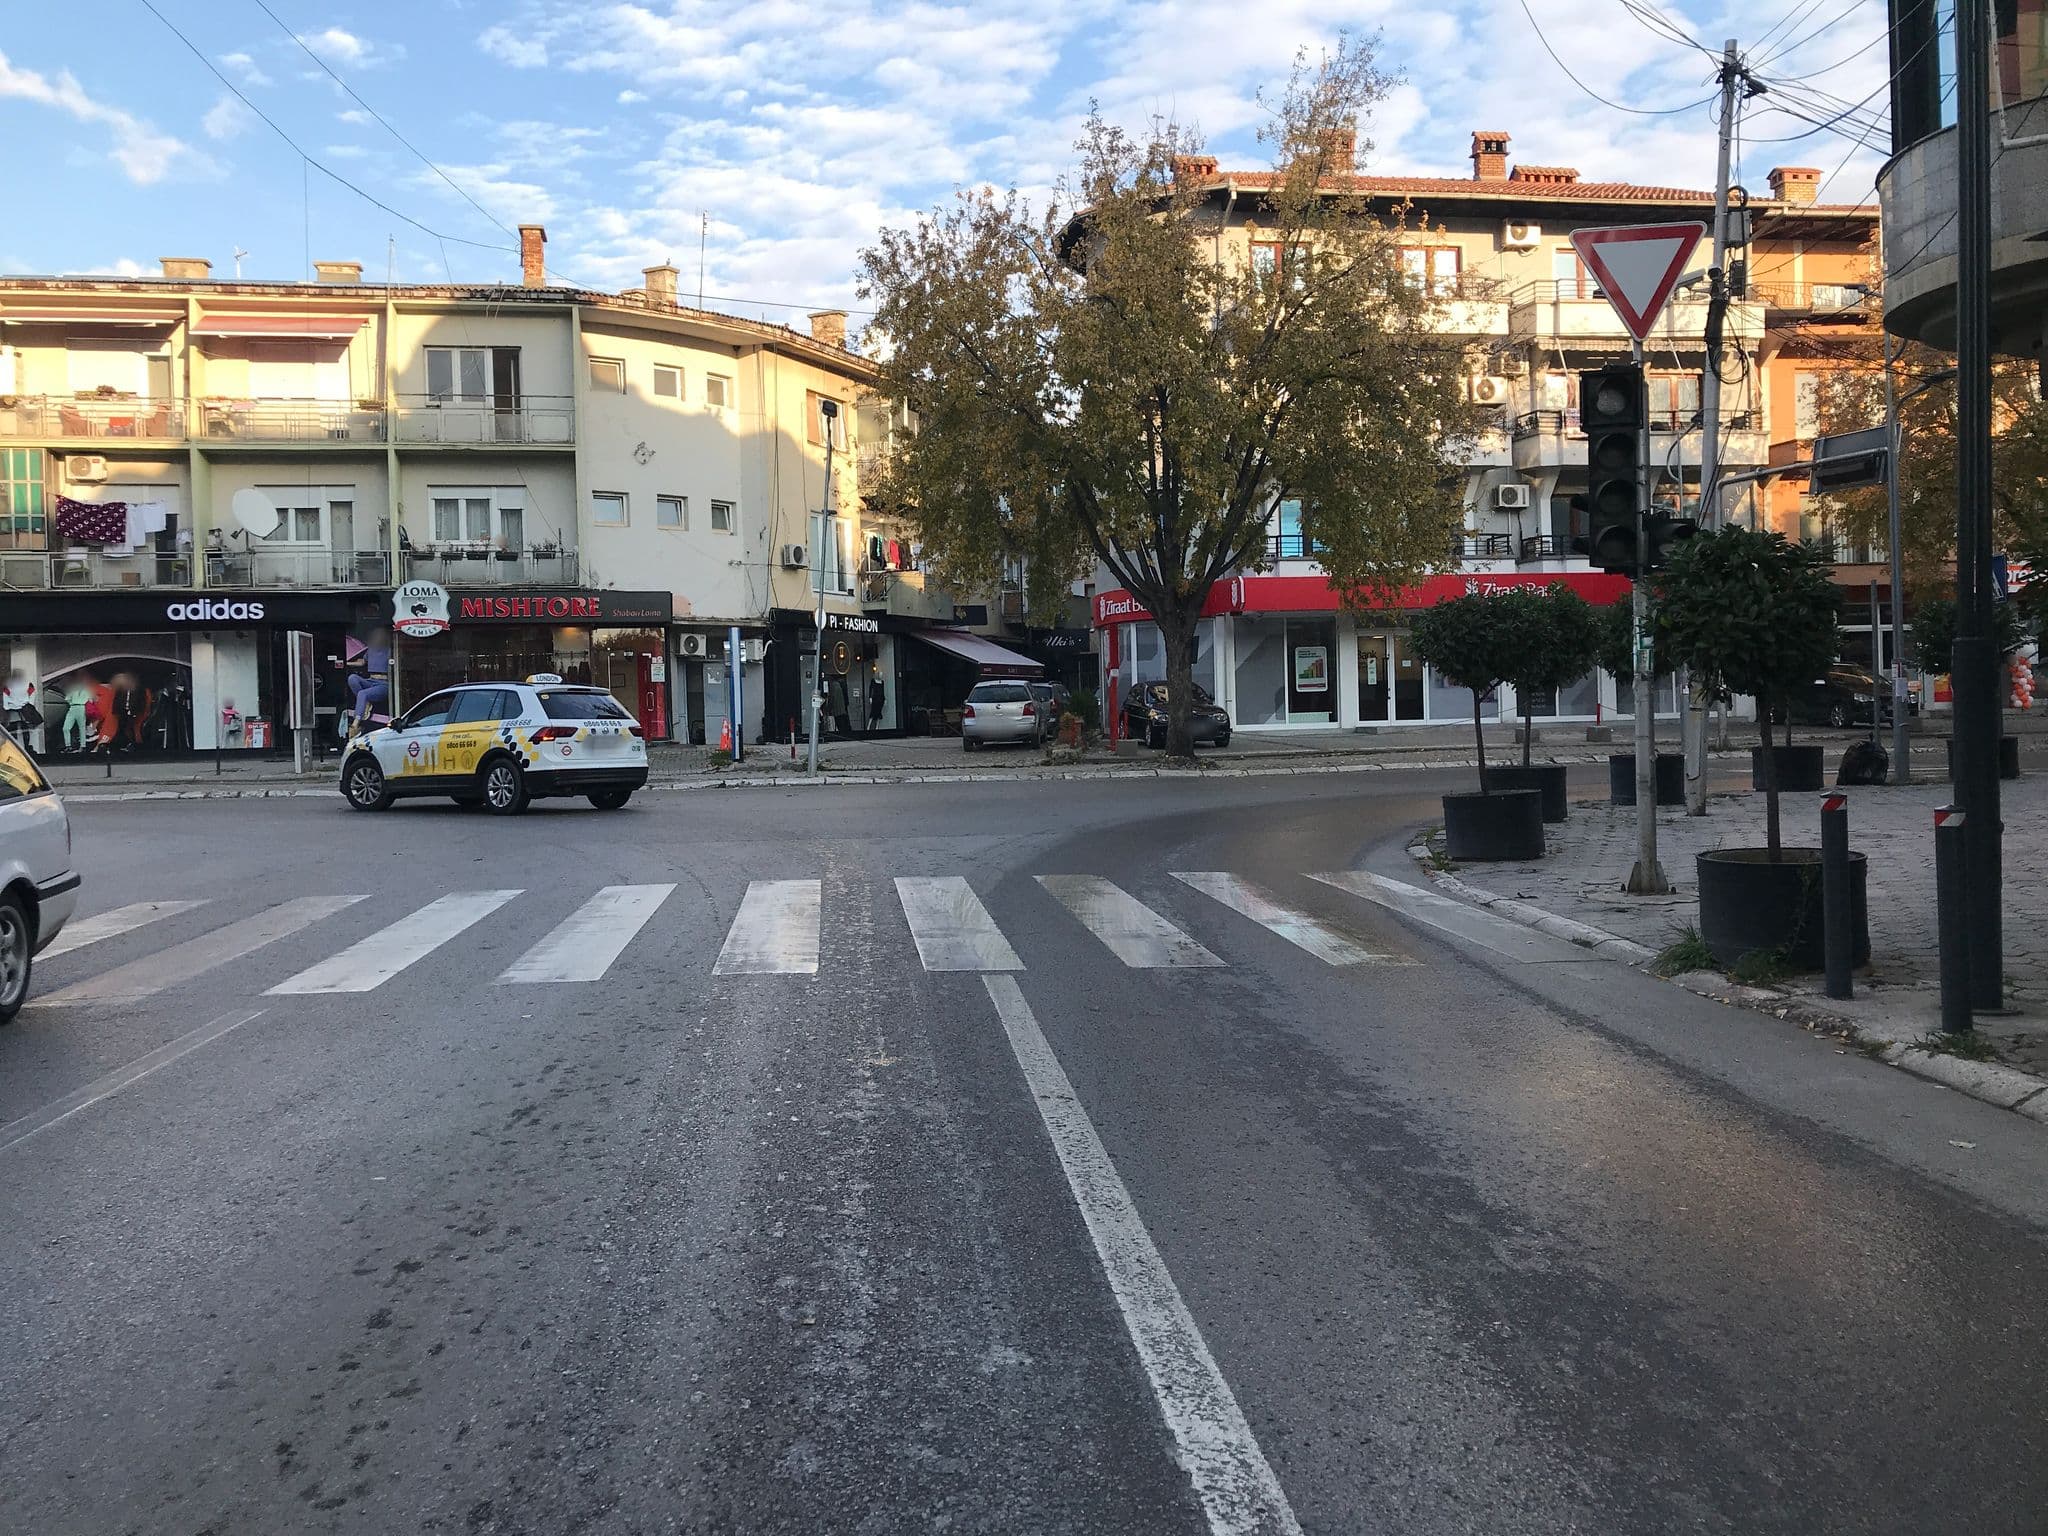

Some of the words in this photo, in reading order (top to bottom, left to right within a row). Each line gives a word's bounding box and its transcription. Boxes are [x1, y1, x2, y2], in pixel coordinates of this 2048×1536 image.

[403, 587, 440, 597] LOMA
[166, 598, 265, 621] adidas
[460, 597, 602, 618] MISHTORE
[1106, 599, 1131, 615] Ziraat
[829, 615, 837, 628] PI
[844, 616, 879, 633] FASHION
[536, 675, 560, 683] LONDON
